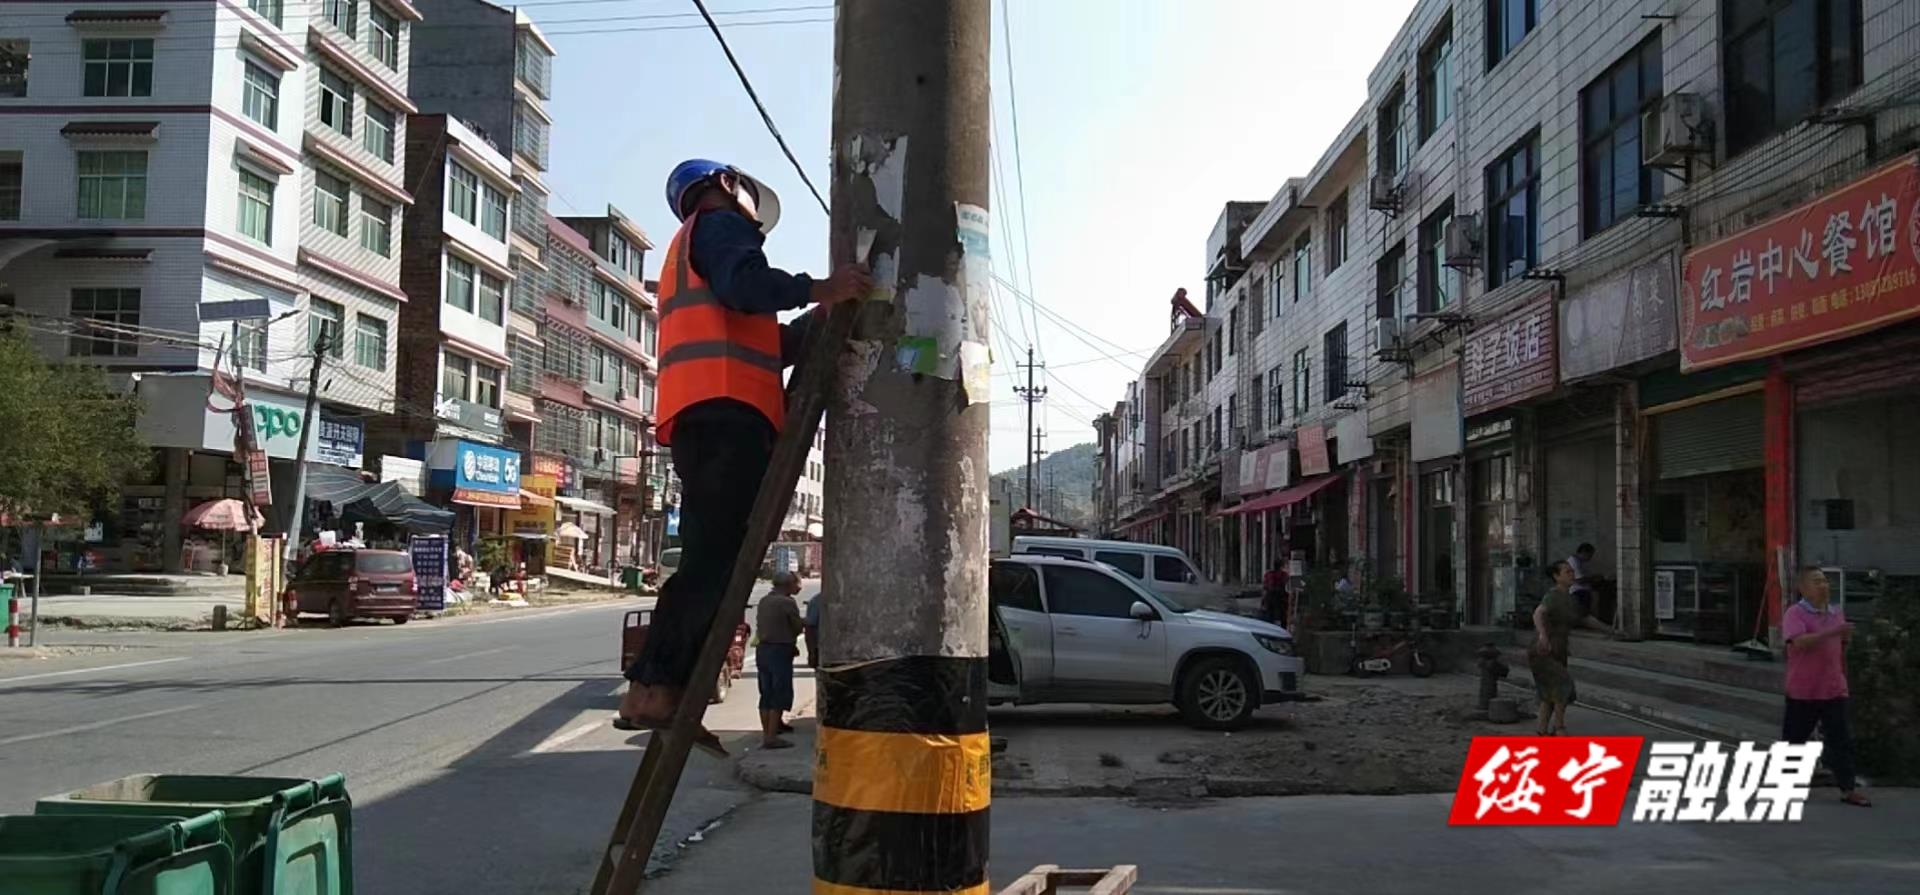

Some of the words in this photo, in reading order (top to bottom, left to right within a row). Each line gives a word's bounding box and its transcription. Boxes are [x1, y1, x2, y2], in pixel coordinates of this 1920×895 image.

[1701, 193, 1897, 311] 红岩中心餐馆
[253, 404, 300, 440] ppo
